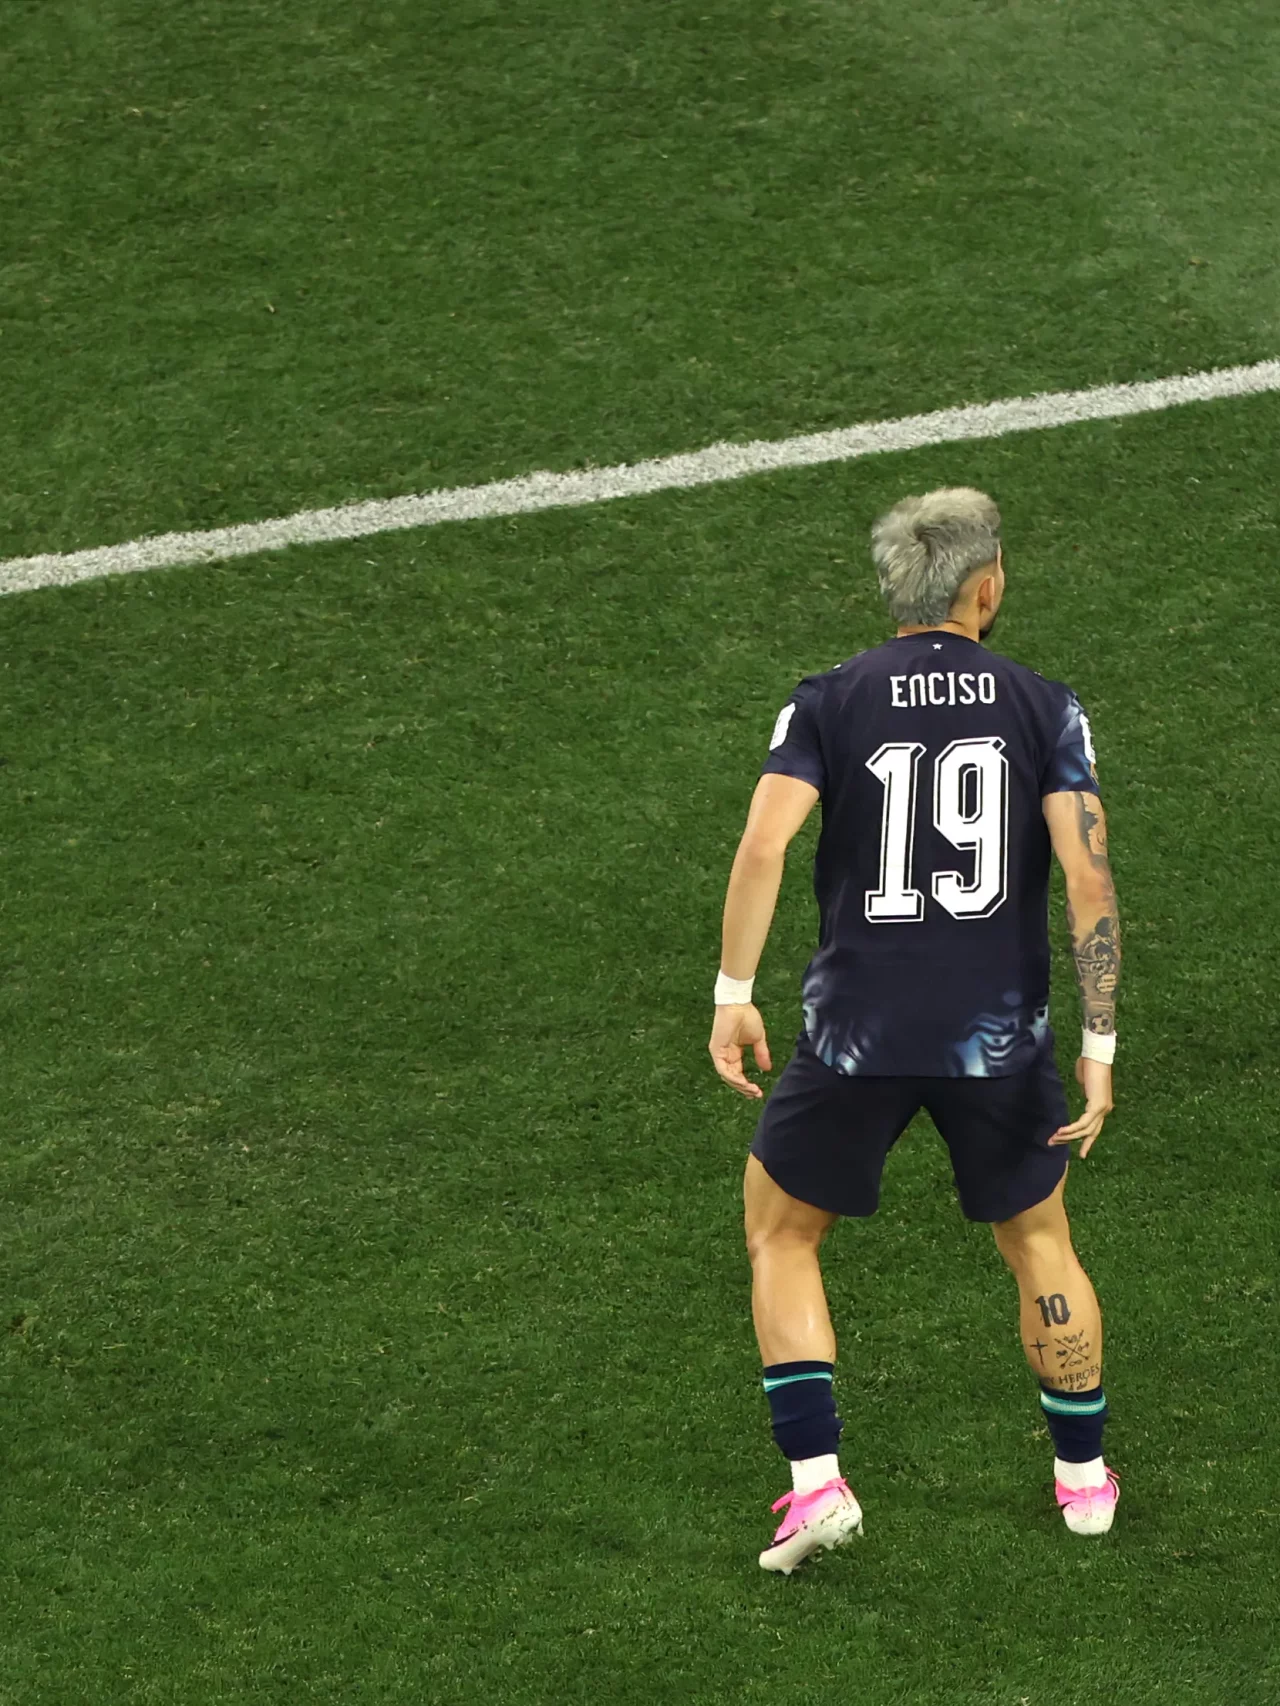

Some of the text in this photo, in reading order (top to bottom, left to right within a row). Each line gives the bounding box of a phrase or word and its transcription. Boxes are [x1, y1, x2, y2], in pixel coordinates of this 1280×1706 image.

[890, 672, 996, 707] ENCISO
[865, 736, 1009, 924] 19
[1035, 1293, 1071, 1328] 10
